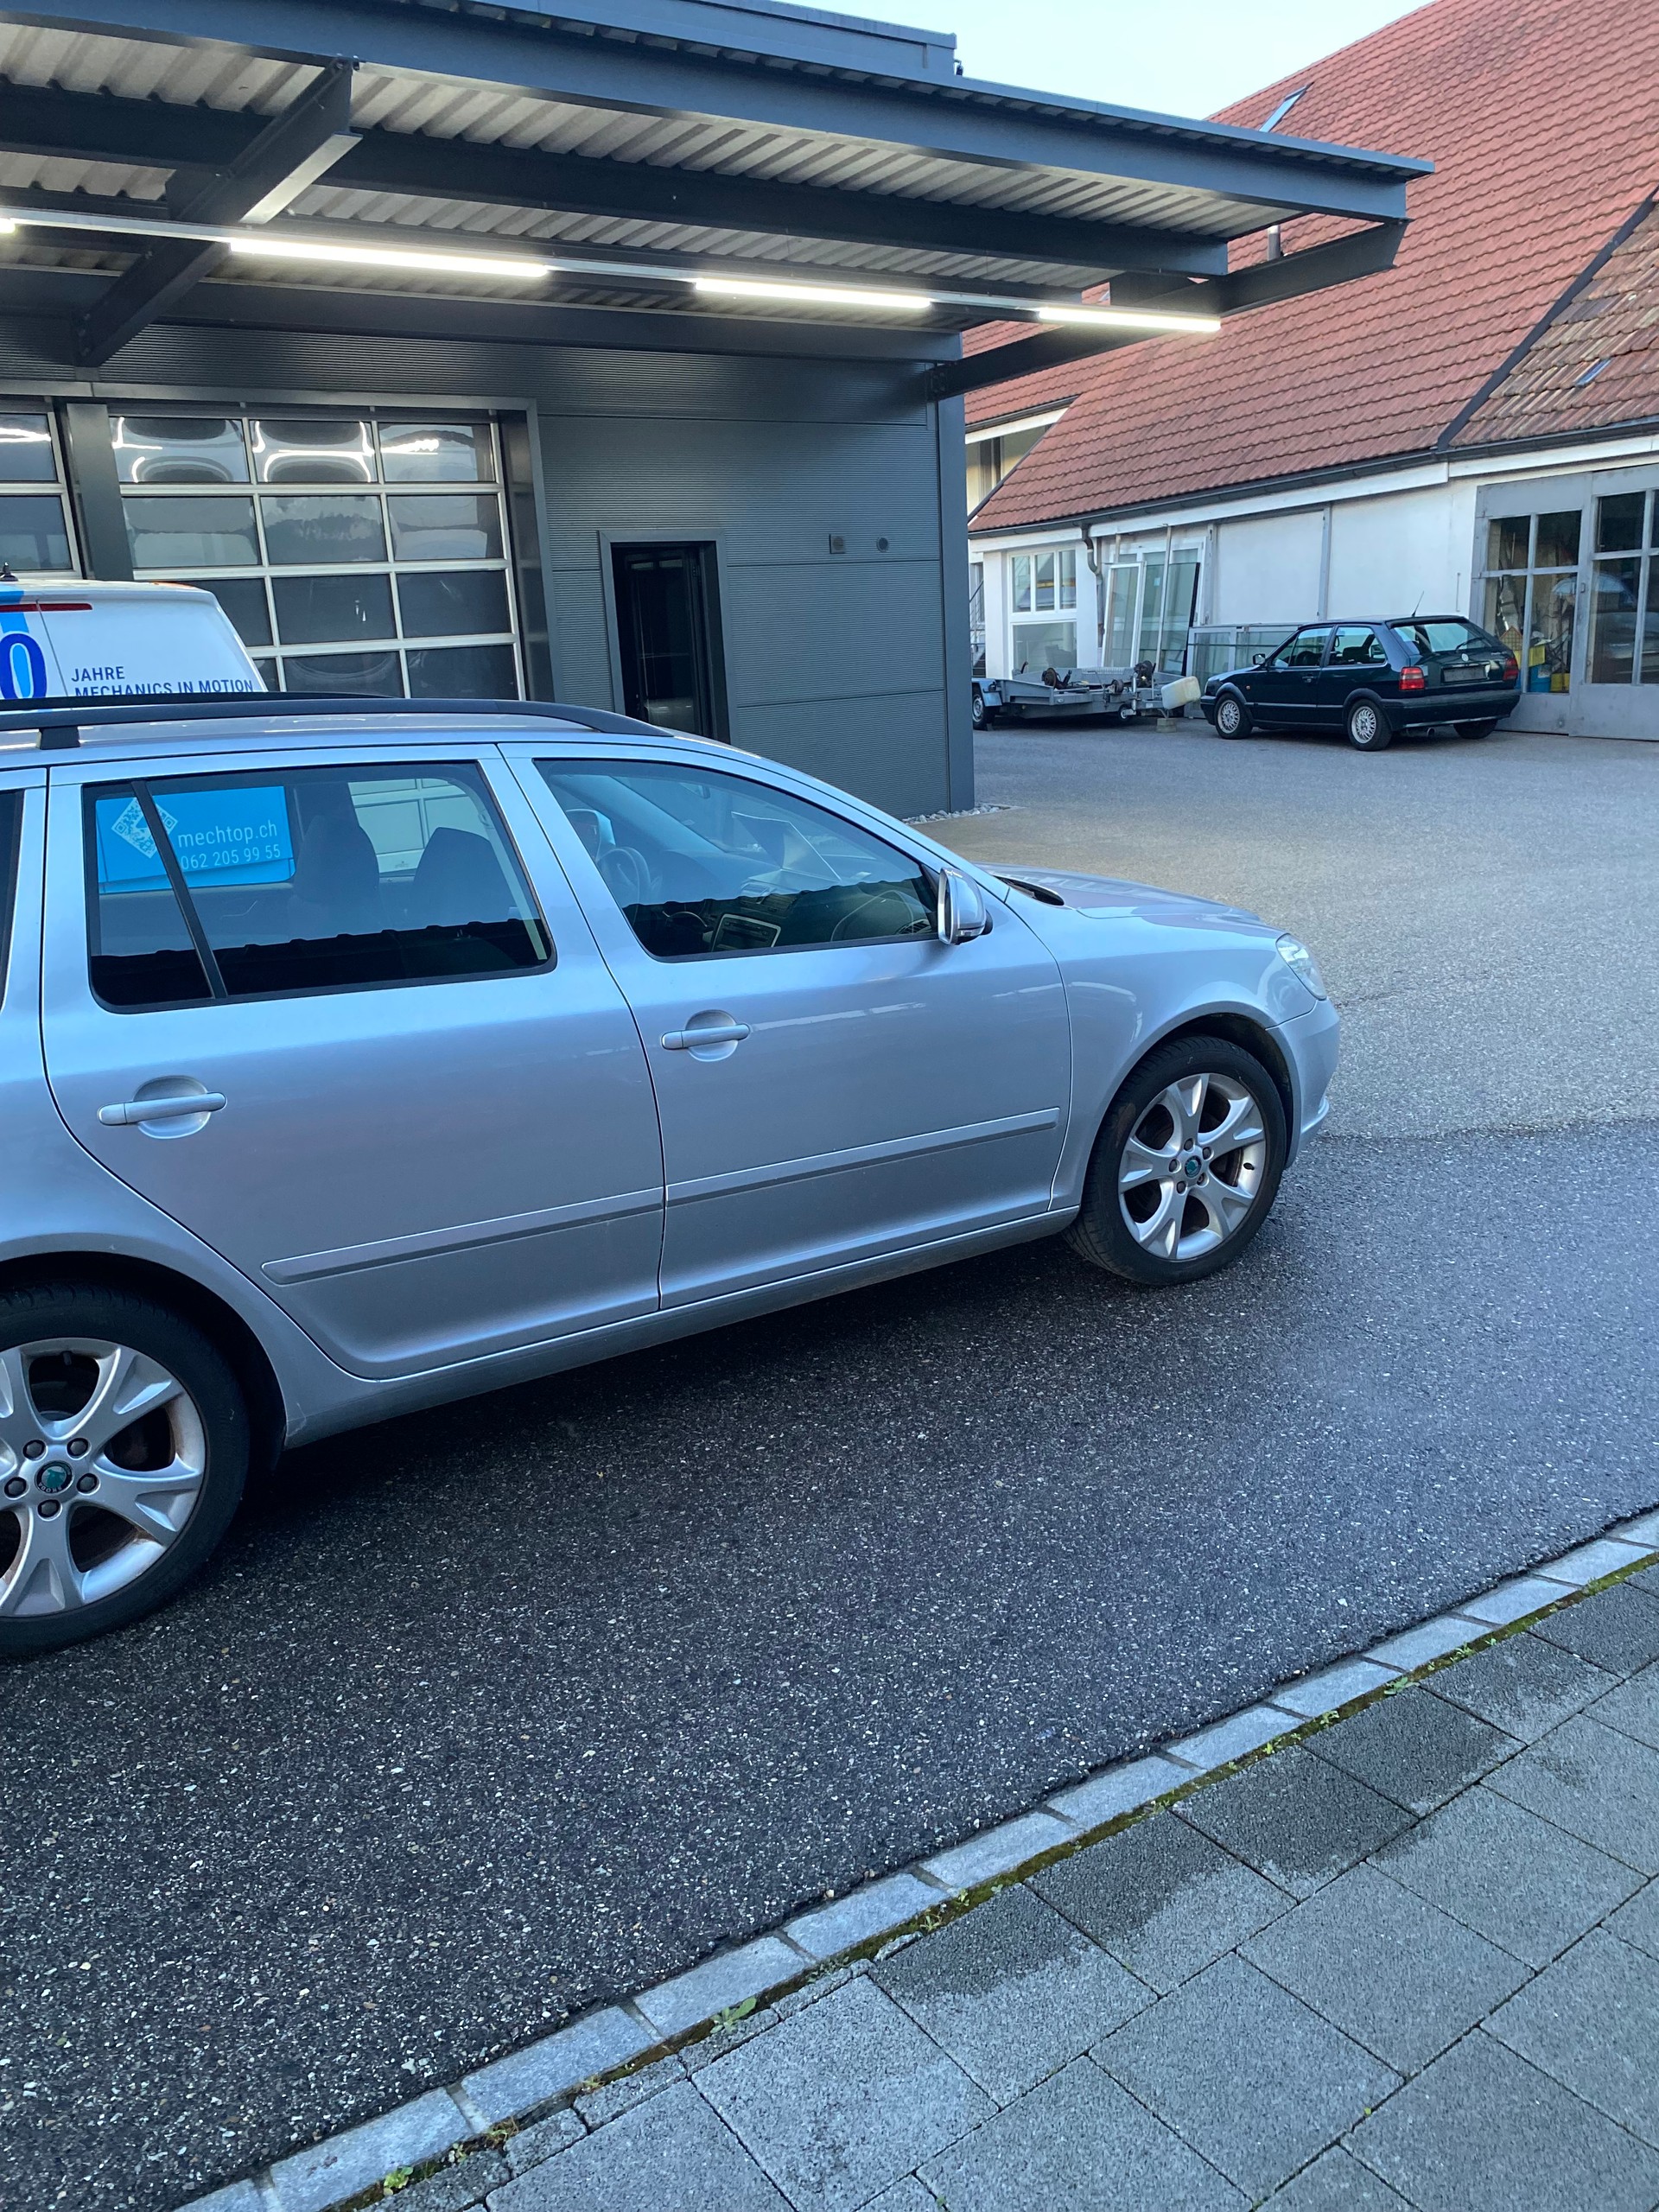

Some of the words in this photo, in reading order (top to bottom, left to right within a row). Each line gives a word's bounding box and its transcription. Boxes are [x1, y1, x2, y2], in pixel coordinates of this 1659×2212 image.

[71, 666, 125, 682] JAHRE
[75, 682, 173, 696] MECHANICS
[178, 681, 194, 693] IN
[199, 679, 253, 693] MOTION
[177, 819, 277, 848] mechtop.ch
[181, 854, 208, 870] 062
[213, 849, 239, 866] 205
[244, 847, 260, 862] 99
[265, 844, 281, 859] 55
